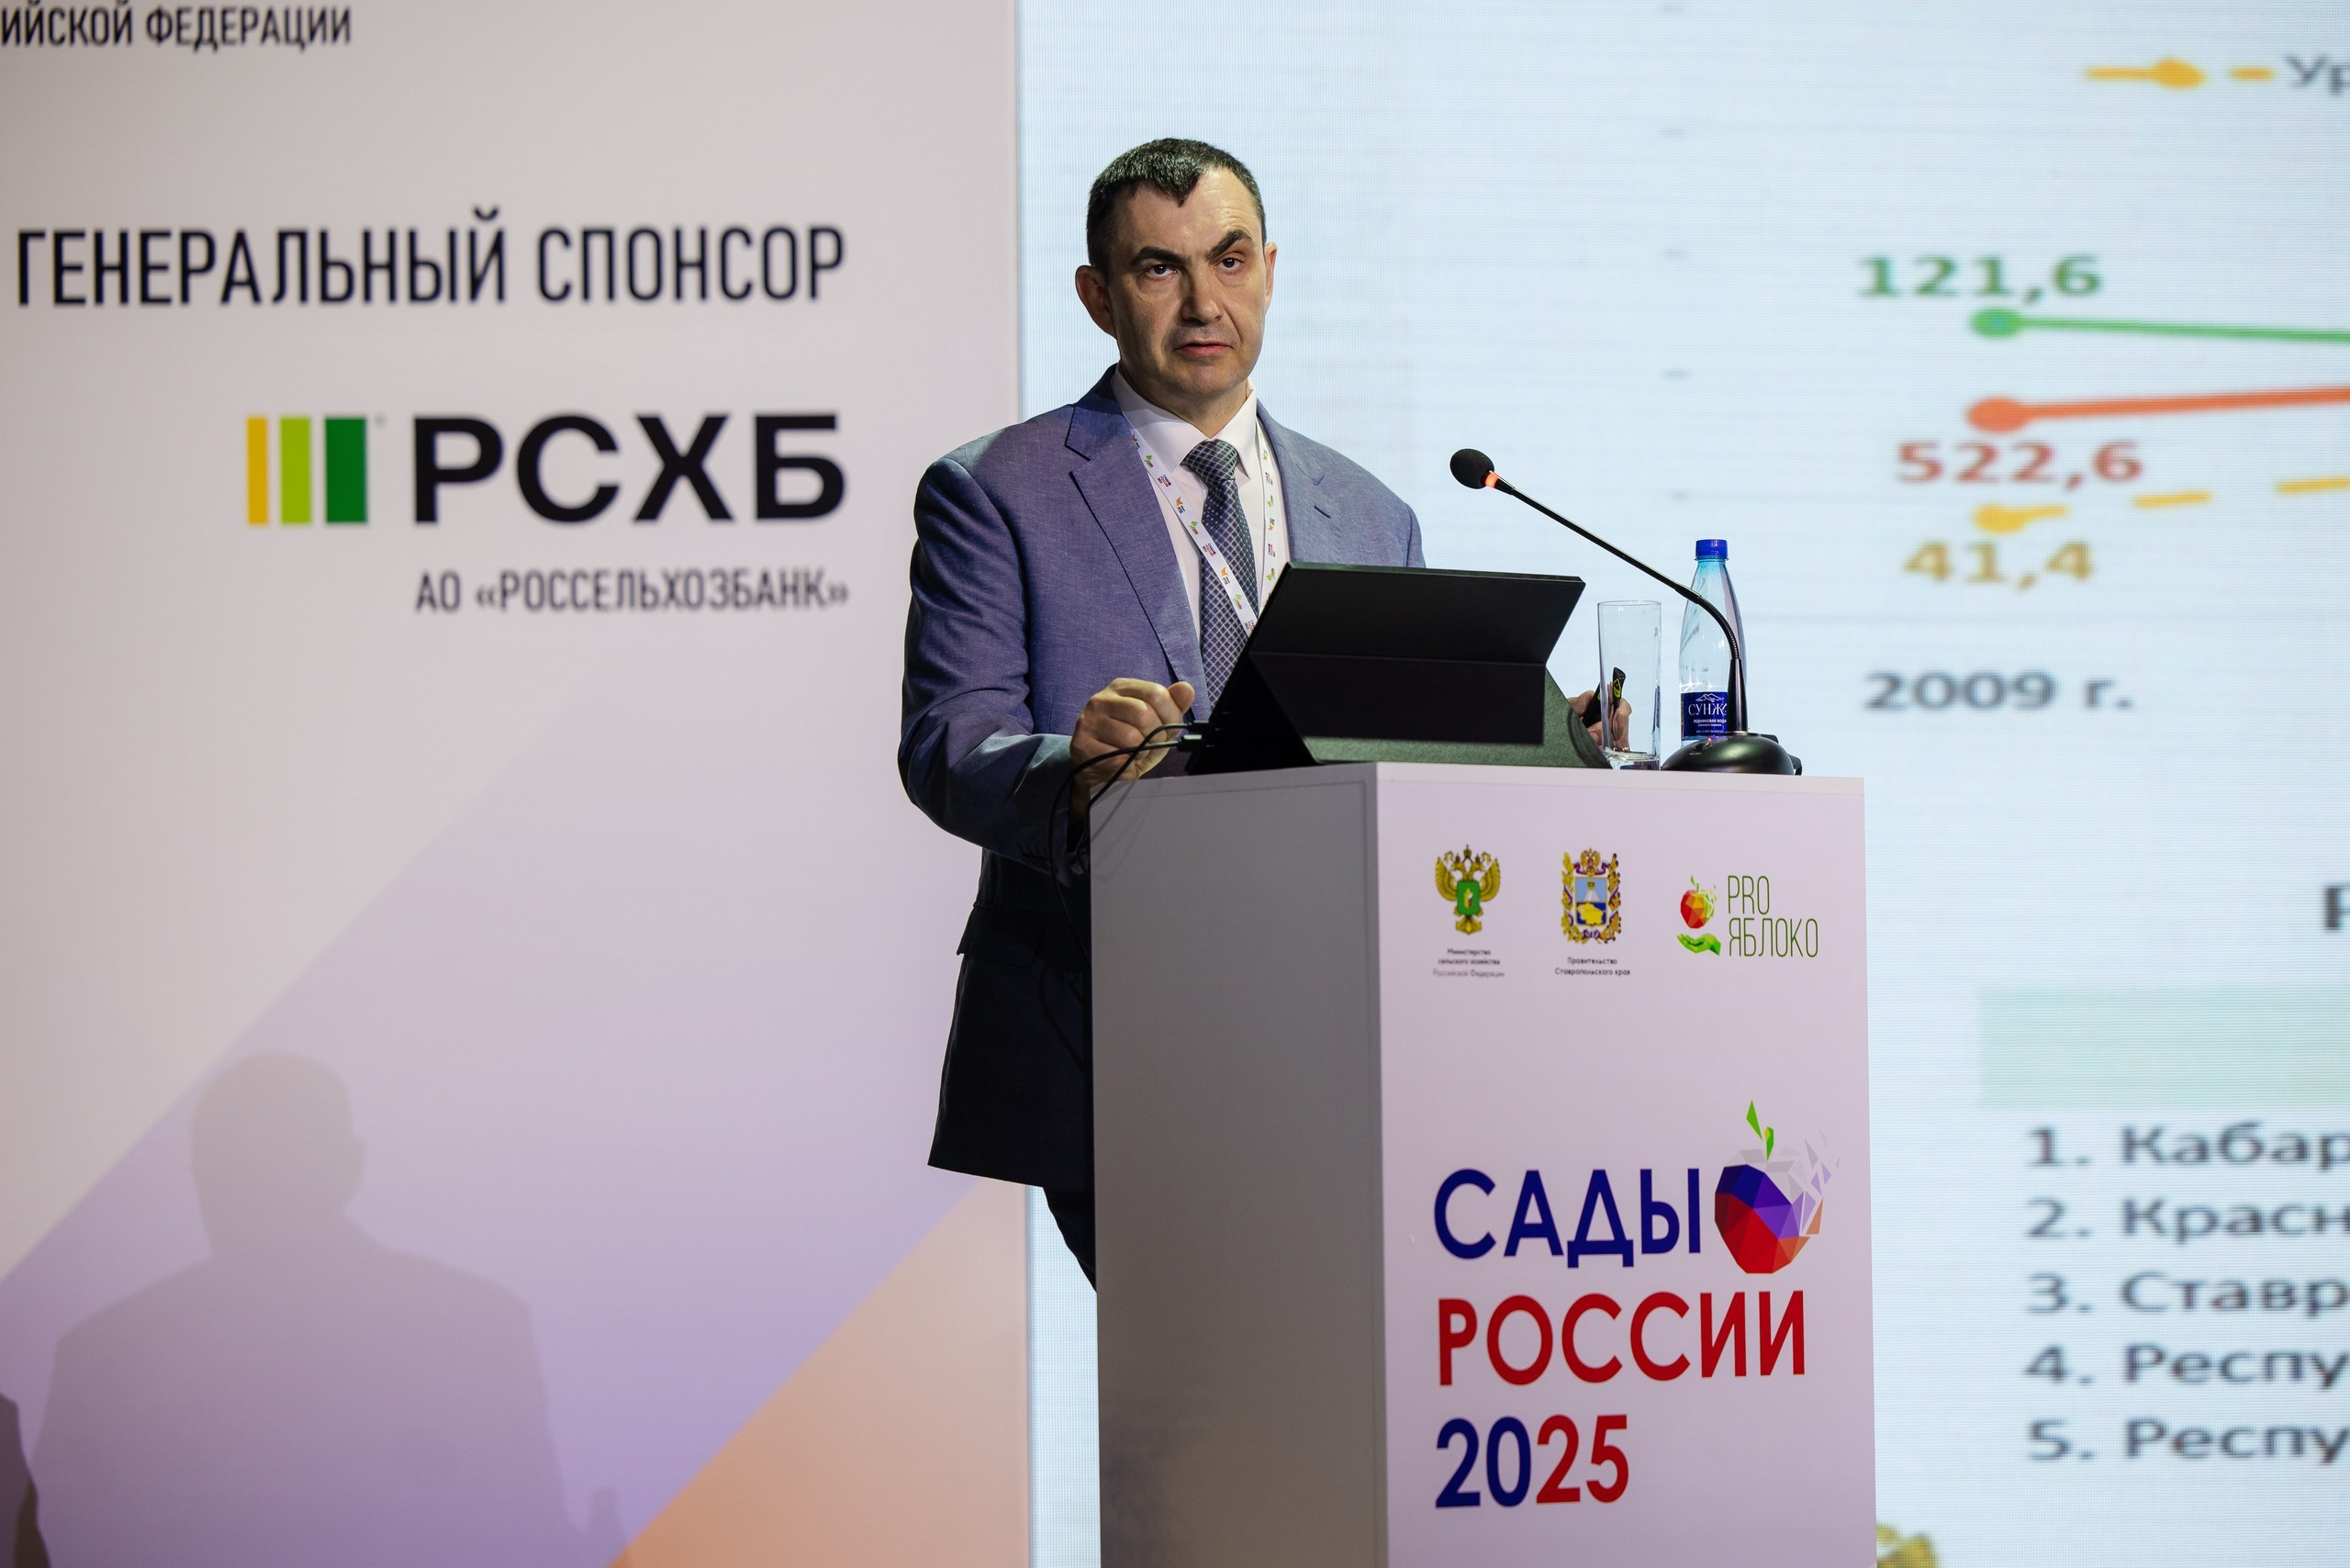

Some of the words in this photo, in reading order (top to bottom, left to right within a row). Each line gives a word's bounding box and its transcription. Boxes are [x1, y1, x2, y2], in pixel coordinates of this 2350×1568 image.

[1, 0, 133, 46] ИЙСКОЙ
[145, 6, 352, 53] ФЕДЕРАЦИИ
[17, 207, 506, 307] ГЕНЕРАЛЬНЫЙ
[537, 226, 845, 304] СПОНСОР
[1859, 255, 2104, 305] 121,6
[412, 413, 846, 524] РСХБ
[1897, 442, 2144, 490] 522,6
[1903, 540, 2096, 590] 41,4
[416, 571, 461, 612] АО
[476, 568, 849, 611] «РОССЕЛЬХОЗБАНК»
[1864, 671, 2059, 711] 2009
[2082, 679, 2133, 711] г.
[1728, 875, 1771, 916] PRO
[1729, 917, 1819, 958] ЯБЛОКО
[2028, 1126, 2090, 1168] 1.
[1434, 1168, 1702, 1269] САДЫ
[2026, 1198, 2092, 1239] 2.
[2028, 1273, 2093, 1314] 3.
[2121, 1272, 2350, 1316] Ставр
[1438, 1290, 1806, 1387] РОССИИ
[2024, 1345, 2093, 1384] 4.
[2123, 1343, 2350, 1390] Респу
[1435, 1414, 1629, 1508] 2025
[2028, 1419, 2095, 1461] 5.
[2125, 1418, 2350, 1466] Респу
